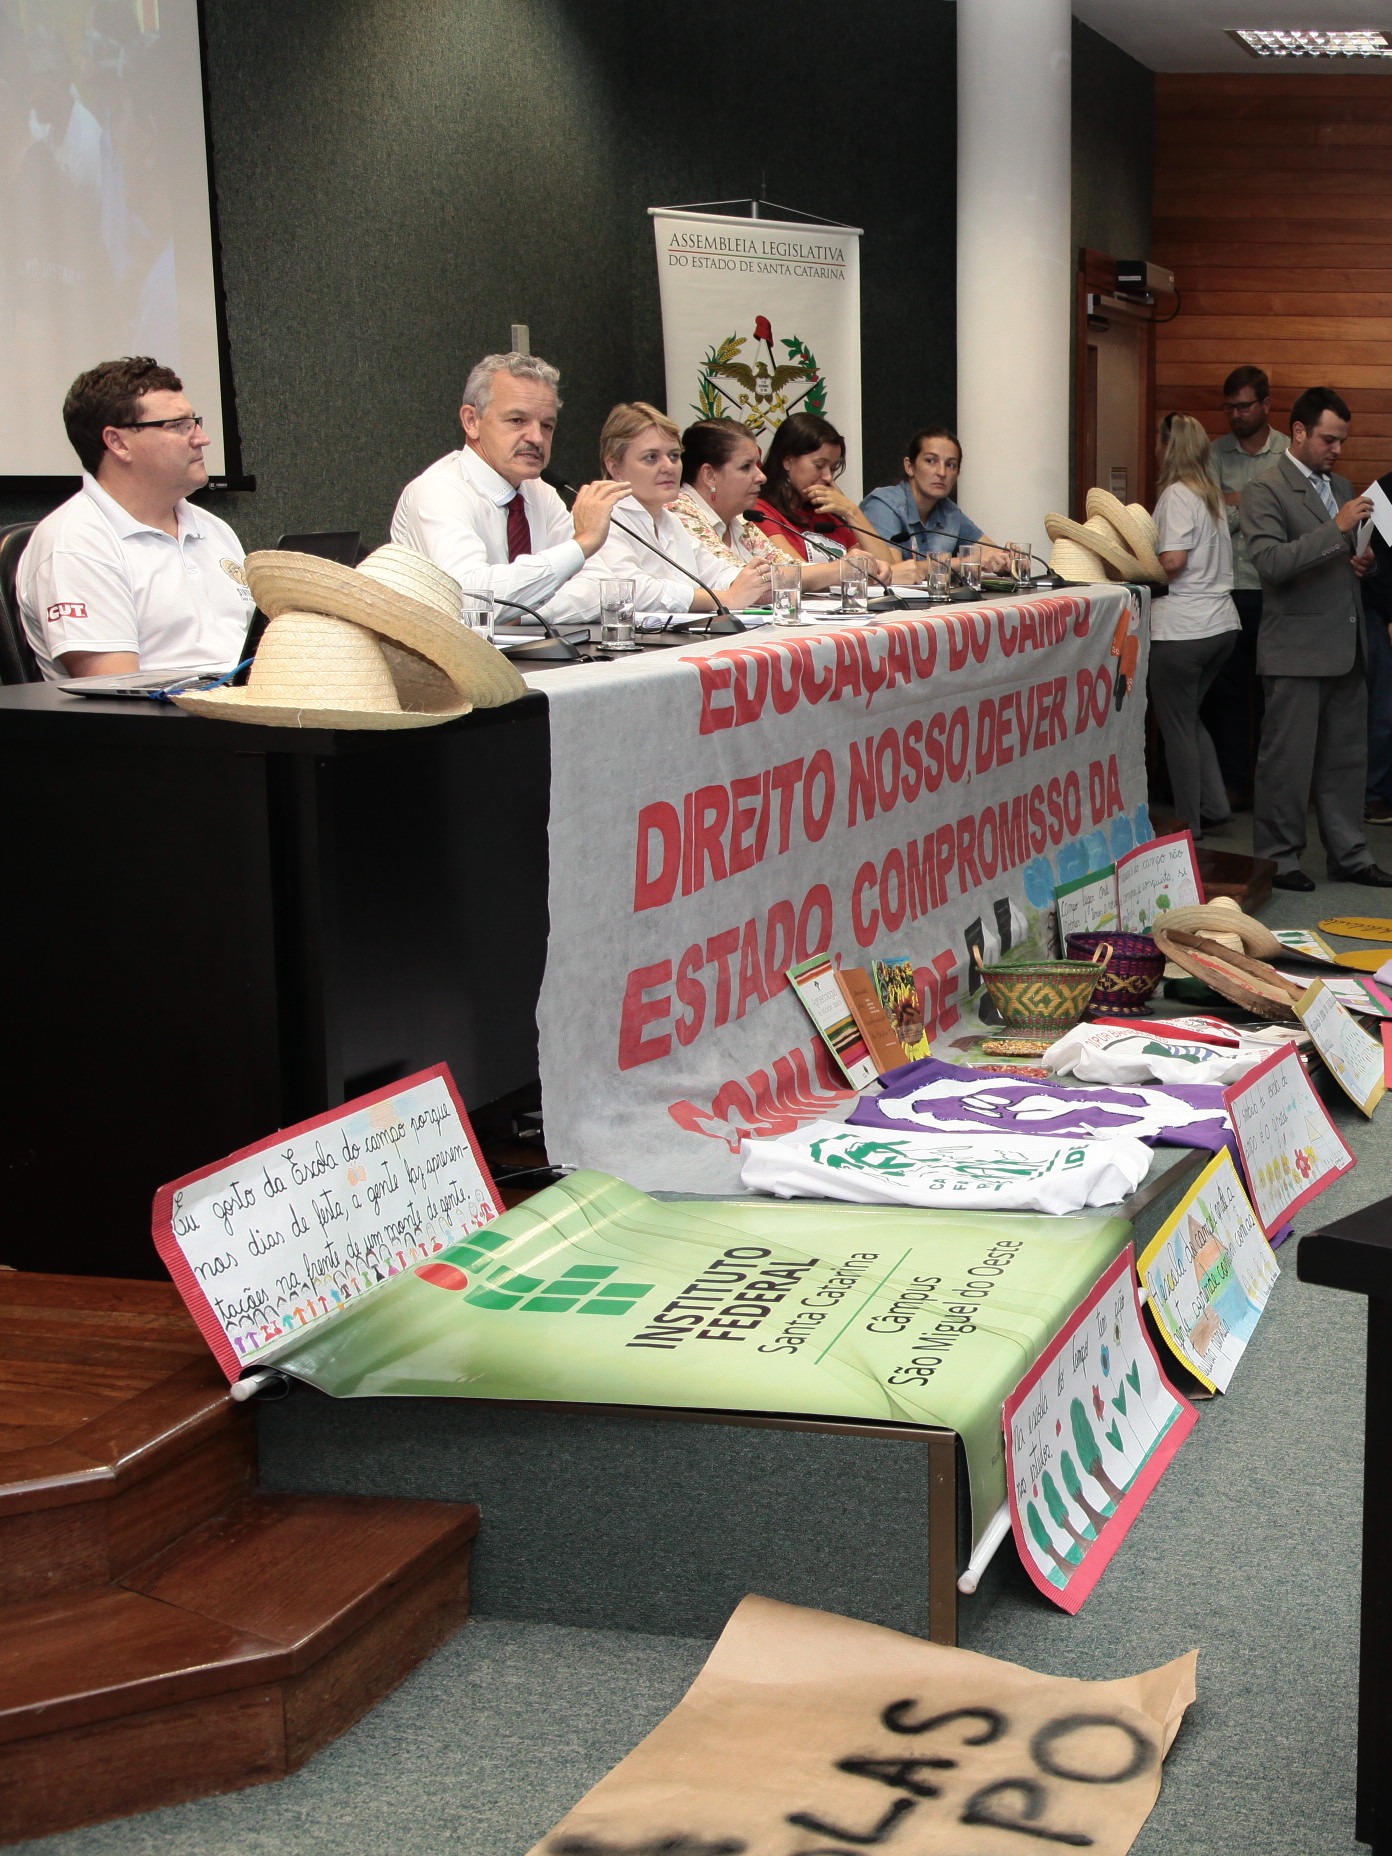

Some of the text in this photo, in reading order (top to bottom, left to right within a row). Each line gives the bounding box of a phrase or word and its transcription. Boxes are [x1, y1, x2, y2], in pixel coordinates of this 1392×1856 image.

[669, 255, 845, 280] DO ESTADO DE SANTA CATARINA
[670, 233, 845, 262] ASSEMBLEIA LEGISLATIVA
[49, 603, 86, 620] CUT
[633, 748, 835, 913] DIREITO
[975, 686, 1070, 776] DEVER
[1075, 664, 1112, 730] DO
[851, 775, 1082, 947] COMPROMISSO
[1088, 753, 1125, 823] DA
[172, 1101, 451, 1237] Eu gosto da Escola do campo porque
[248, 1222, 286, 1257] dias
[291, 1203, 311, 1234] de
[352, 1194, 363, 1209] a
[366, 1160, 400, 1217] gente
[404, 1158, 426, 1198] faz
[213, 1286, 269, 1323] tações
[275, 1272, 302, 1295] na
[303, 1240, 340, 1296] frente
[363, 1227, 385, 1252] um
[384, 1200, 423, 1240] monte
[960, 1277, 996, 1301] do
[968, 1239, 1024, 1278] Oeste
[626, 1246, 772, 1350] INSTITUTO
[695, 1258, 822, 1342] FEDERAL
[757, 1251, 880, 1356] Santa Catarina
[866, 1275, 942, 1335] Câmpus
[911, 1300, 979, 1353] Miguel
[888, 1350, 943, 1387] São
